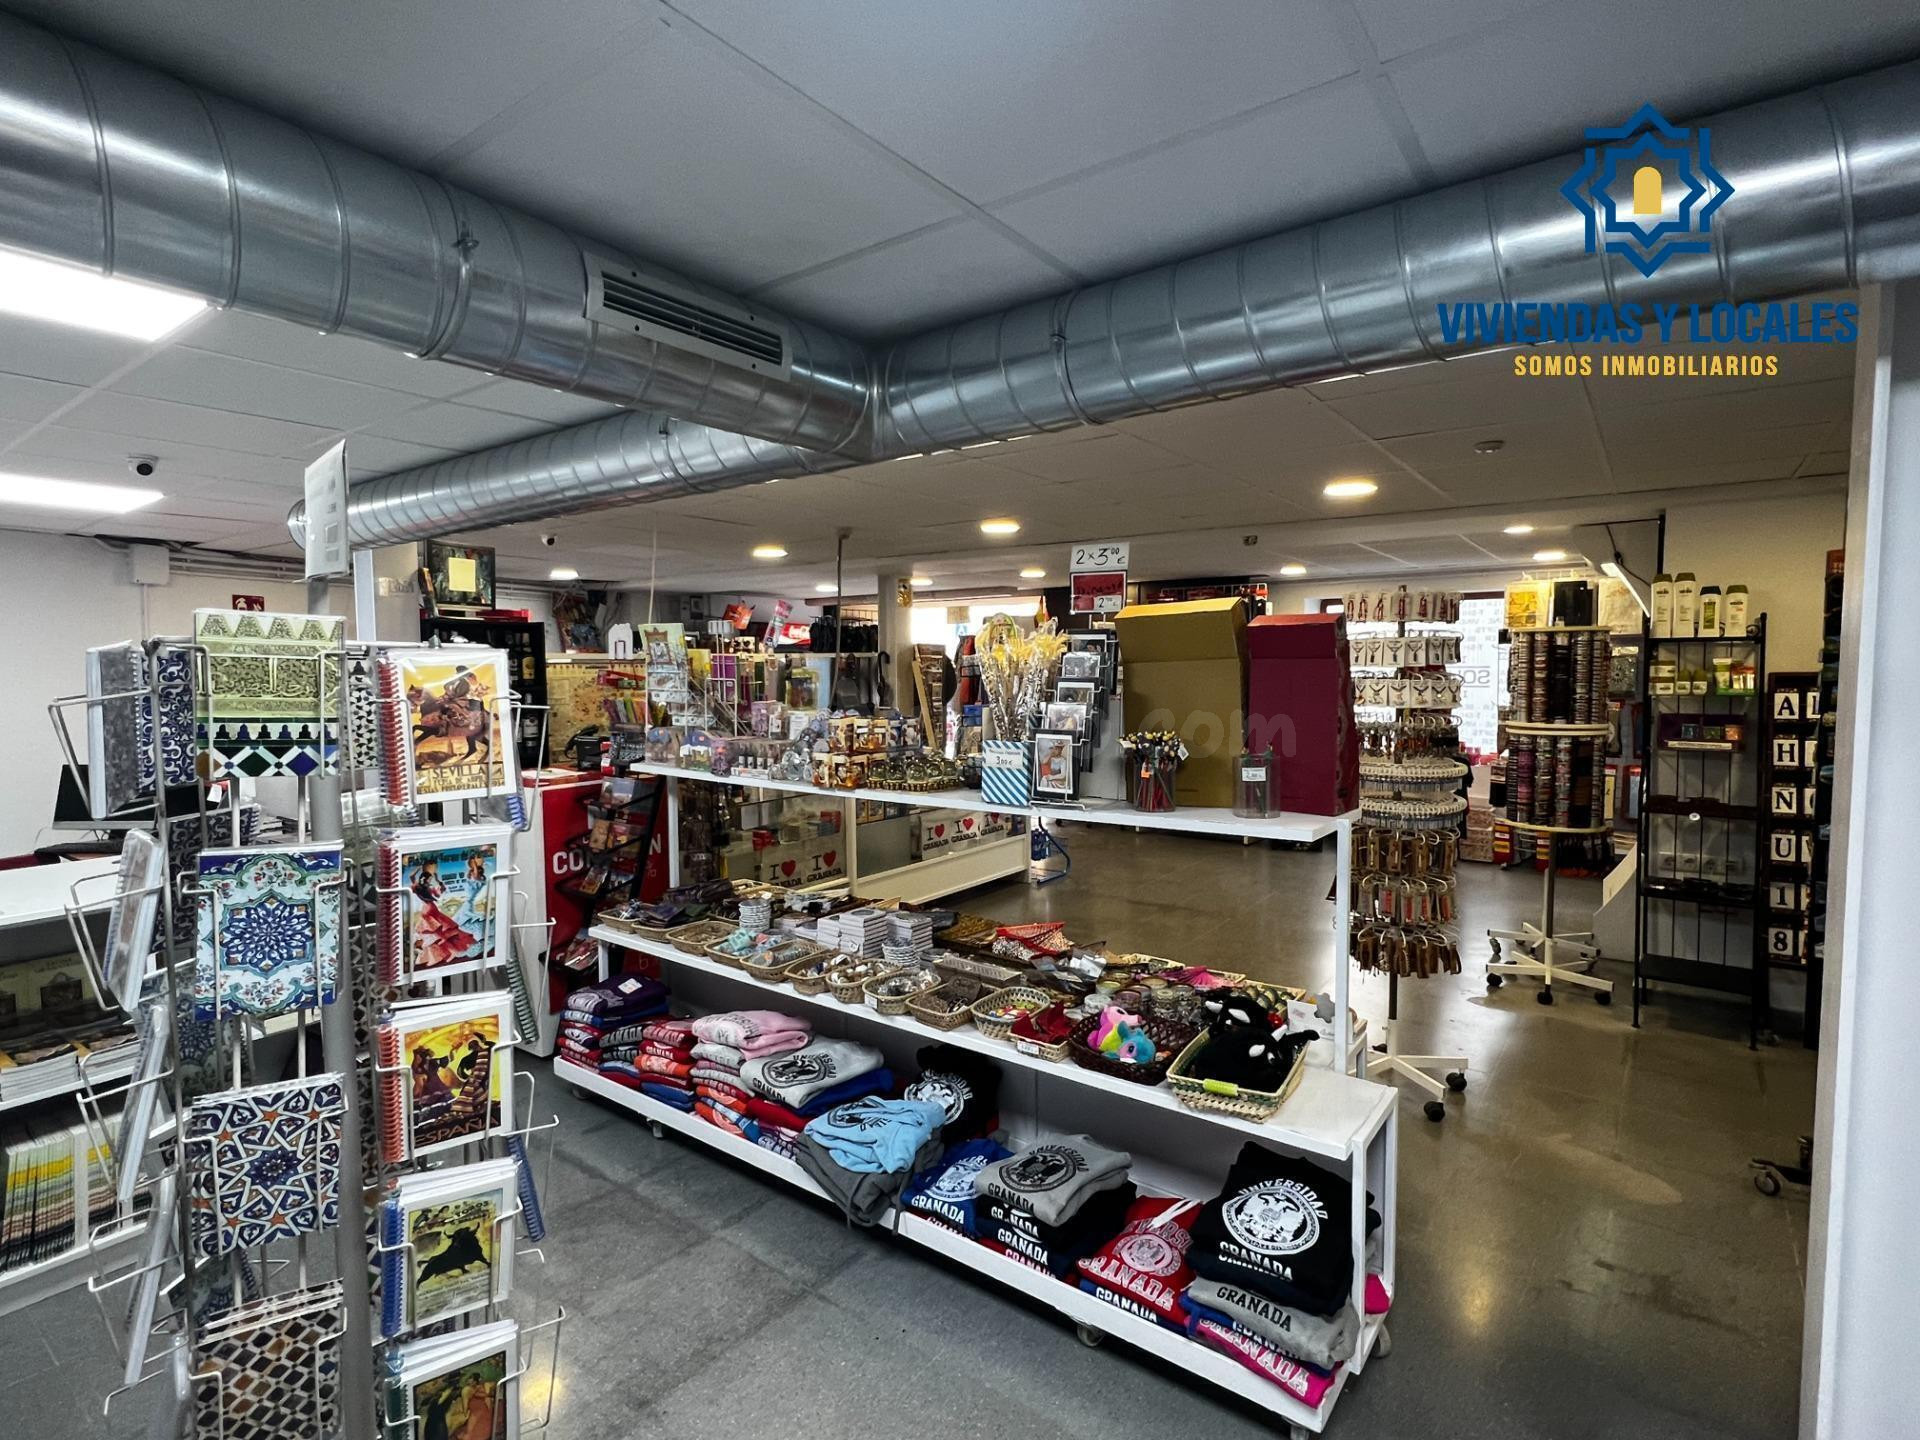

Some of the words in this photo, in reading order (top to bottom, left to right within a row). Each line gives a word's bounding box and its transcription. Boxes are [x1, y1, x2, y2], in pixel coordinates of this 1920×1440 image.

[1777, 695, 1796, 716] A
[1777, 743, 1796, 763] H
[1775, 838, 1791, 858] U
[1774, 931, 1788, 951] 8
[911, 1195, 965, 1225] GRANADA
[1238, 1178, 1329, 1219] UNIVERSIDAD
[997, 1228, 1048, 1266] GRANADA
[1078, 1256, 1175, 1312] GRANADA
[1217, 1286, 1292, 1333] GRANADA
